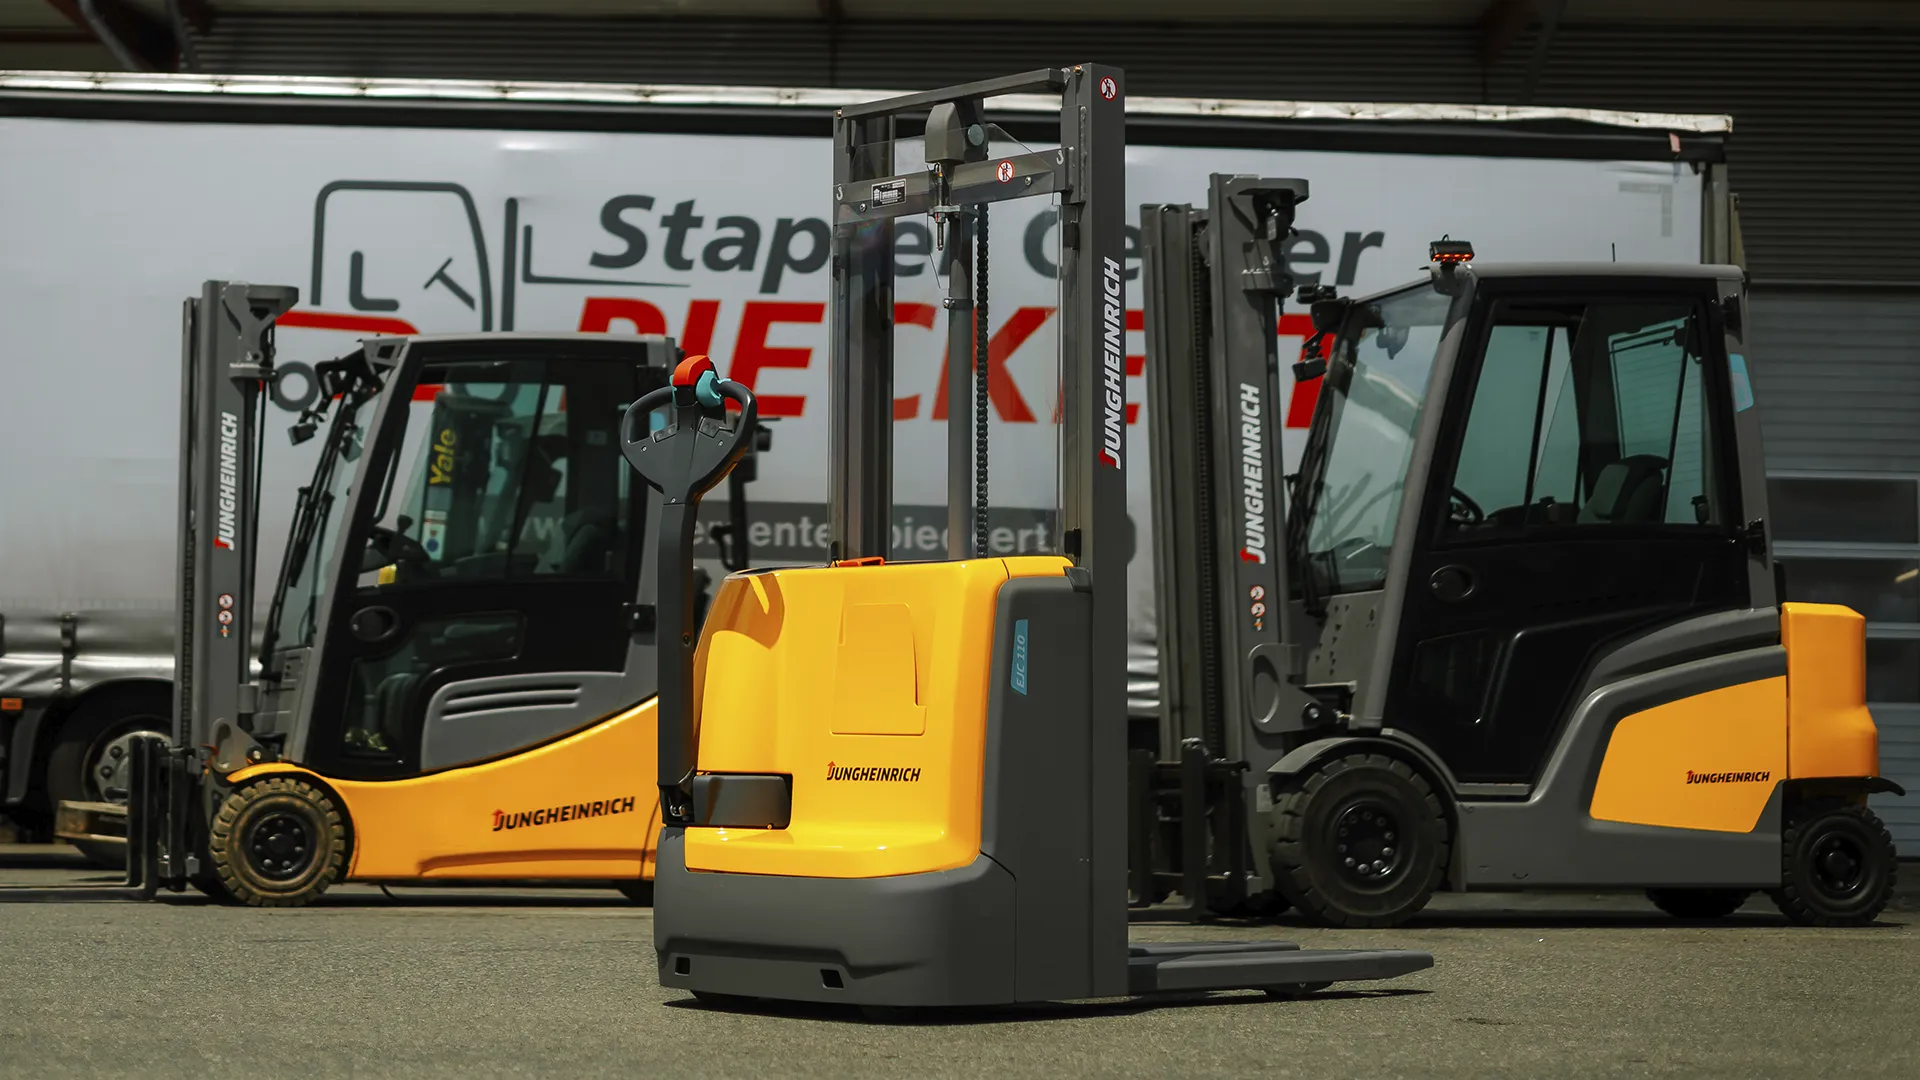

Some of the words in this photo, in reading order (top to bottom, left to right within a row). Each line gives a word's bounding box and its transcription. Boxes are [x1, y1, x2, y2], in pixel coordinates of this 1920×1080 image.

[1098, 257, 1122, 469] JUNGHEINRICH
[429, 428, 456, 484] Yale
[1240, 383, 1266, 564] JUNGHEINRICH
[214, 412, 238, 551] JUNGHEINRICH
[1016, 634, 1026, 660] 110
[1016, 663, 1025, 688] EJC
[826, 761, 921, 782] JUNGHEINRICH
[1686, 769, 1770, 784] JUNGHEINRICH
[492, 796, 636, 832] JUNGHEINRICH
